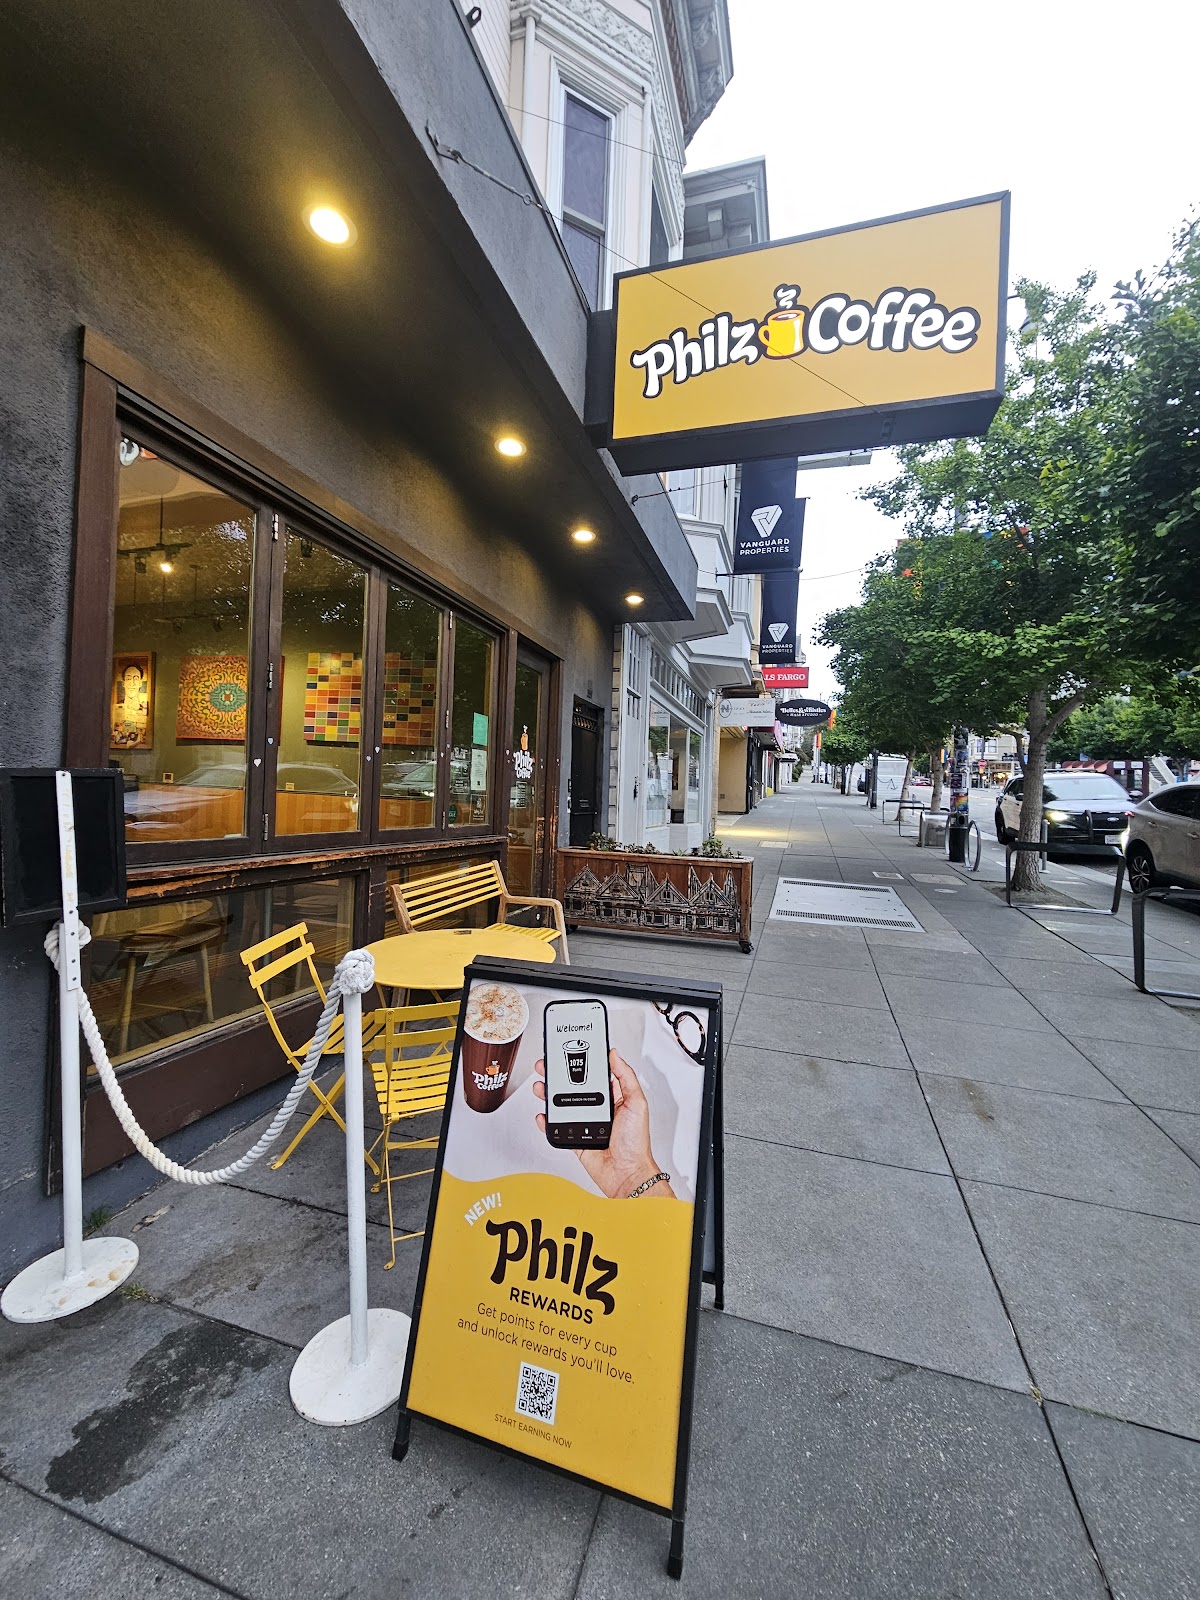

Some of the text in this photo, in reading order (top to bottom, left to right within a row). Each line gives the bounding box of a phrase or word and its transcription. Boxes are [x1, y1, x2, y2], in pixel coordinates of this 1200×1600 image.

[631, 287, 980, 397] Philz Coffee
[740, 538, 790, 549] VANGUARD
[740, 547, 790, 555] PROPERTIES
[513, 750, 533, 773] Philz
[556, 1023, 593, 1033] Welcome!
[472, 1071, 508, 1085] Philz
[477, 1082, 504, 1090] Coffee
[464, 1192, 502, 1226] NEW!
[486, 1218, 618, 1315] Philz
[510, 1287, 594, 1325] REWARDS
[477, 1302, 617, 1357] Get points for every cup
[457, 1316, 635, 1384] and unlock rewards you'll love.
[494, 1413, 573, 1448] START EARNING NOW
